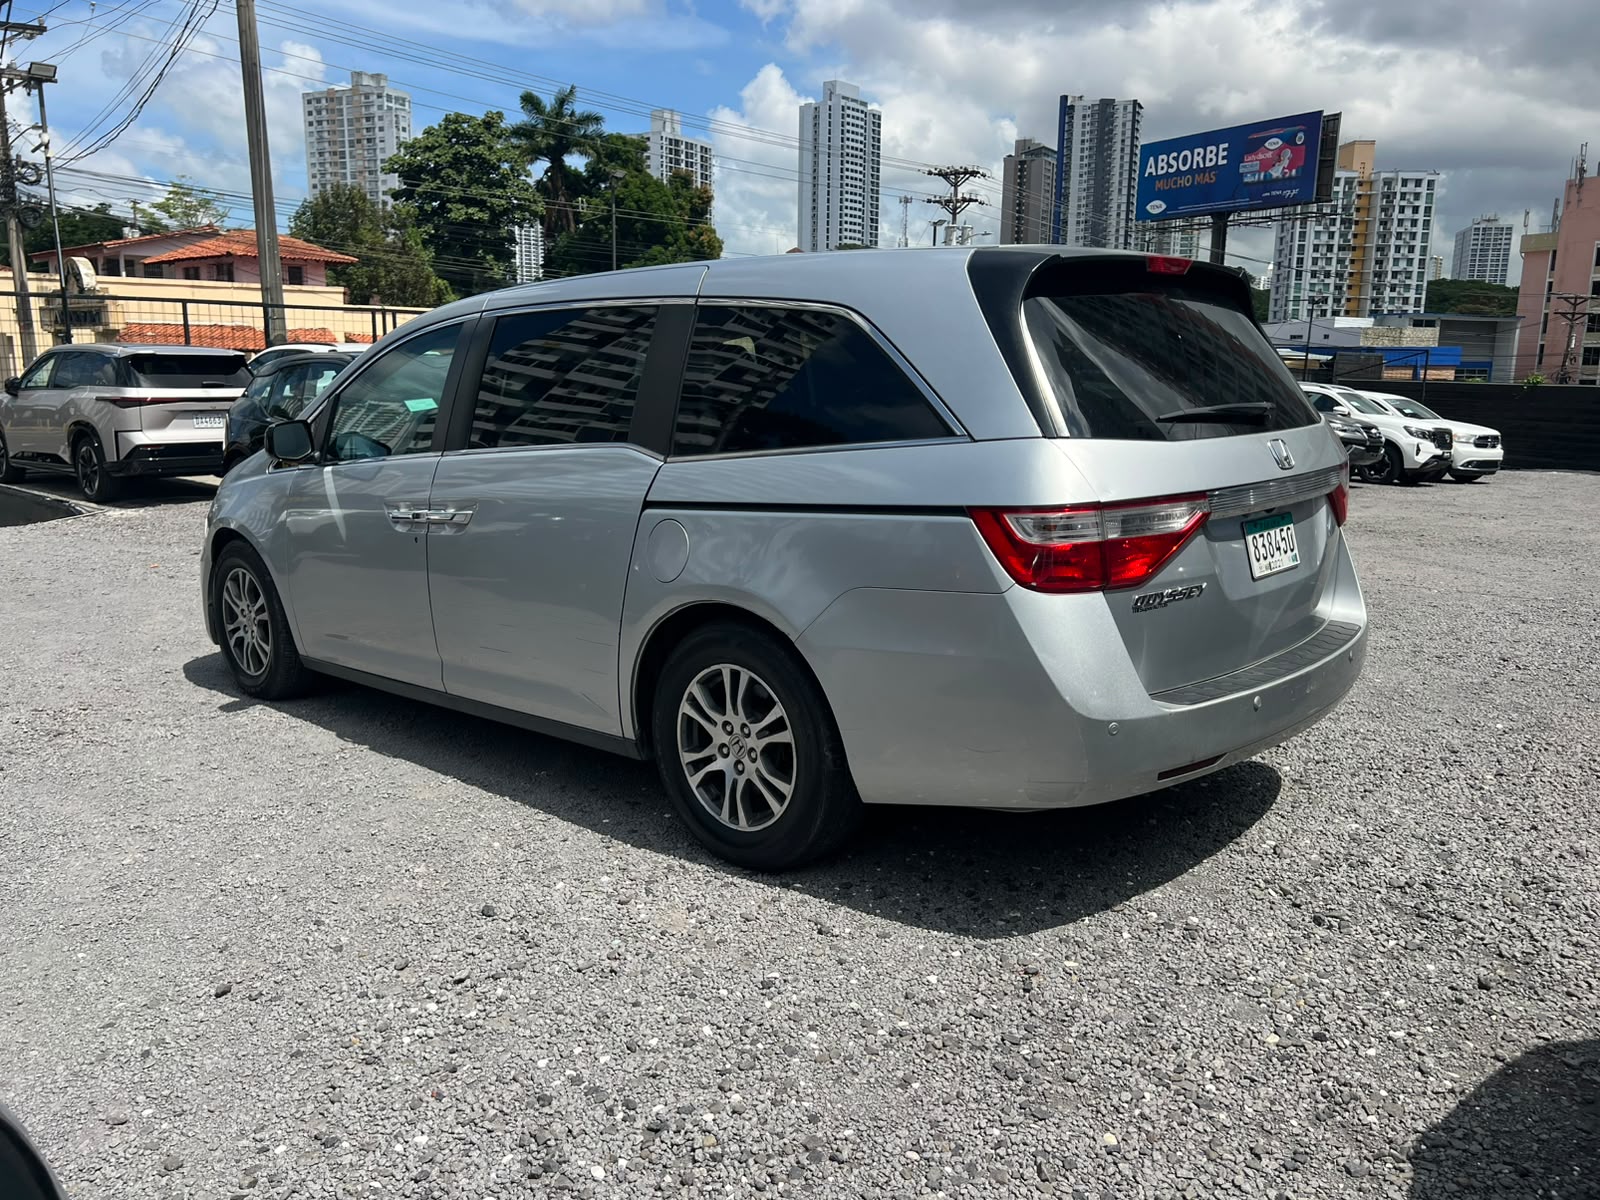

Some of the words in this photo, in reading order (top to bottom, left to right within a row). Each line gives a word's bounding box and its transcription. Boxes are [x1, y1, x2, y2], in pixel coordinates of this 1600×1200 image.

[1144, 143, 1229, 177] ABSORBE
[1155, 174, 1192, 192] MUCHO
[1194, 171, 1216, 185] MÁS
[1252, 526, 1295, 563] 838450
[1133, 582, 1207, 608] ODYSSEY
